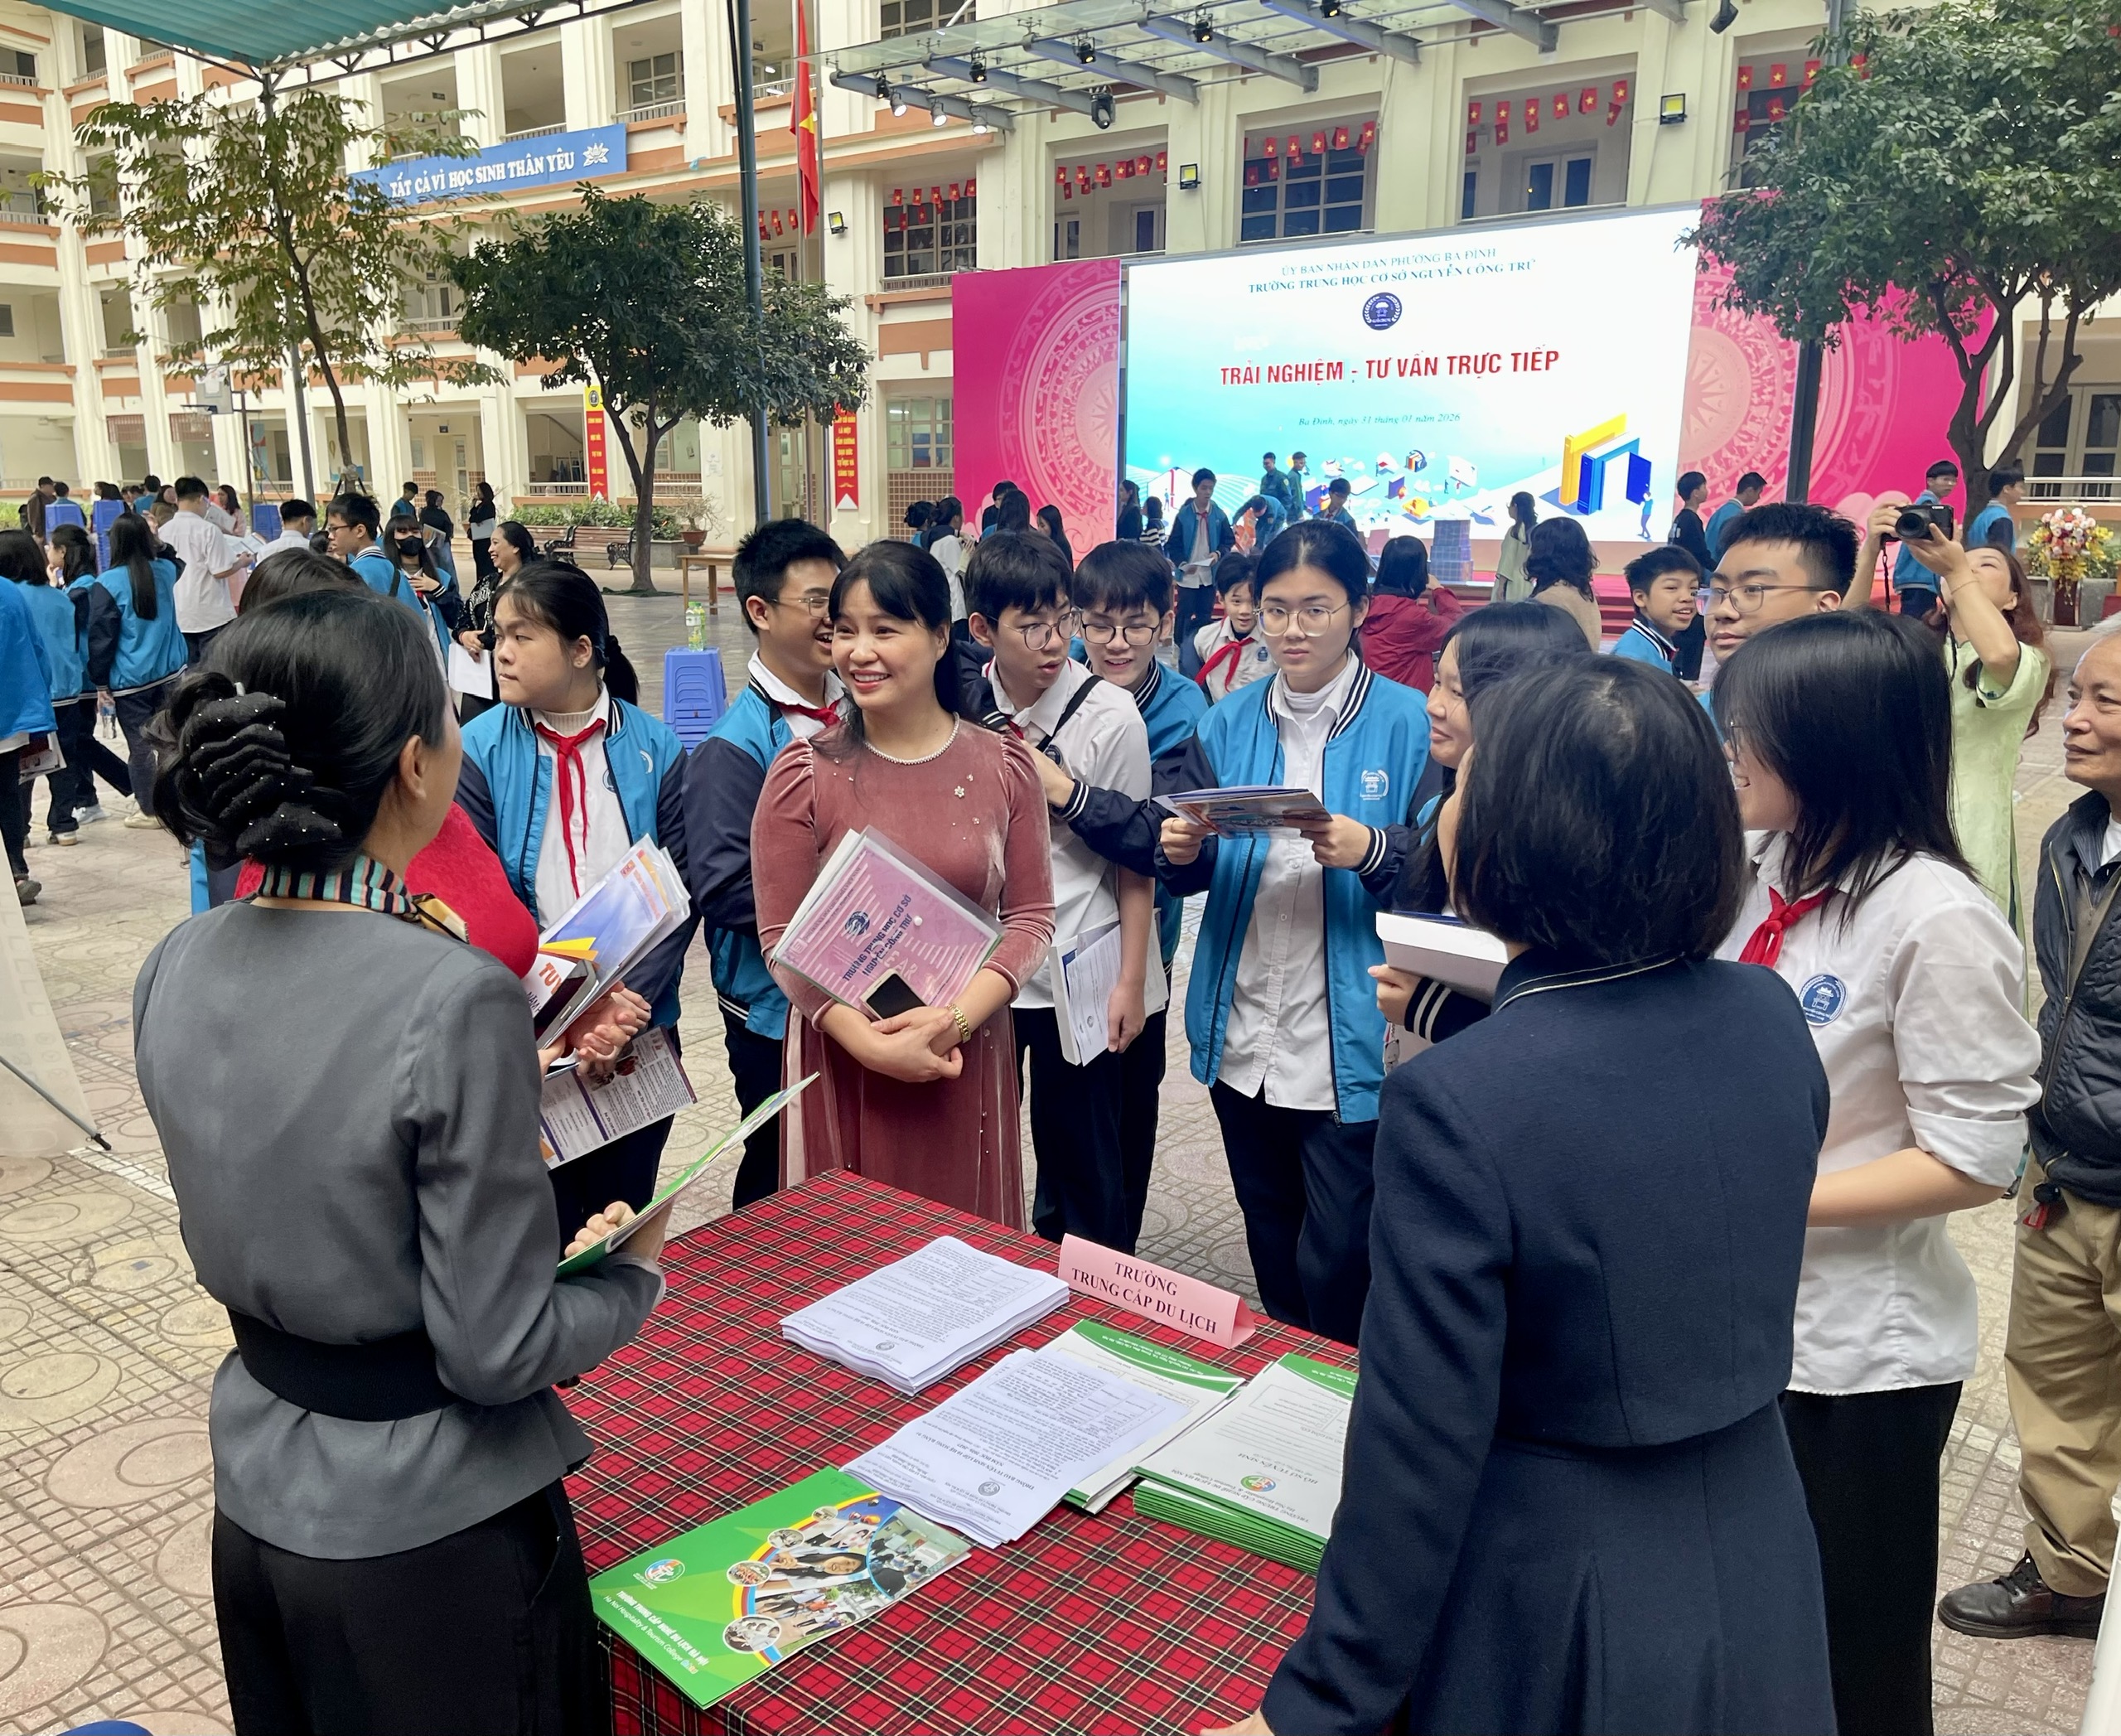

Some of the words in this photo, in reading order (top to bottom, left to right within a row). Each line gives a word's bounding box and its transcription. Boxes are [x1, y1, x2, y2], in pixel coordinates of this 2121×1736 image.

[415, 170, 430, 195] CẢ
[432, 168, 446, 191] VÌ
[449, 172, 474, 191] HỌC
[476, 163, 506, 184] SINH
[507, 152, 544, 179] THÂN
[546, 147, 575, 172] YÊU
[1249, 279, 1295, 293] TRƯỜNG
[1299, 277, 1338, 289] TRUNG
[1341, 274, 1368, 288] HỌC
[1370, 272, 1389, 283] CƠ
[1391, 268, 1408, 282] SỞ
[1466, 260, 1504, 275] CÔNG
[1301, 263, 1323, 274] BAN
[1445, 251, 1461, 263] BA
[1220, 360, 1261, 385] TRẢI
[1267, 357, 1344, 386] NGHIỆM
[1366, 357, 1393, 380] TƯ
[1397, 350, 1438, 377] VẤN
[1447, 351, 1502, 380] TRỰC
[1511, 344, 1560, 373] TIẾP
[1298, 418, 1309, 426] Ba
[1337, 417, 1359, 428] ngày
[1375, 415, 1399, 426] tháng
[1437, 413, 1461, 423] 2026
[893, 904, 904, 918] CƠ
[901, 894, 911, 907] SỞ
[899, 913, 912, 930] TRỨ
[1114, 1261, 1178, 1296] TRƯỜNG
[1071, 1267, 1119, 1297] TRUNG
[1123, 1289, 1152, 1308] CẤP
[1156, 1300, 1177, 1318] DU
[1180, 1309, 1217, 1334] LỊCH
[618, 1605, 644, 1627] Hospitality
[645, 1628, 665, 1646] Tourism
[663, 1644, 683, 1661] College
